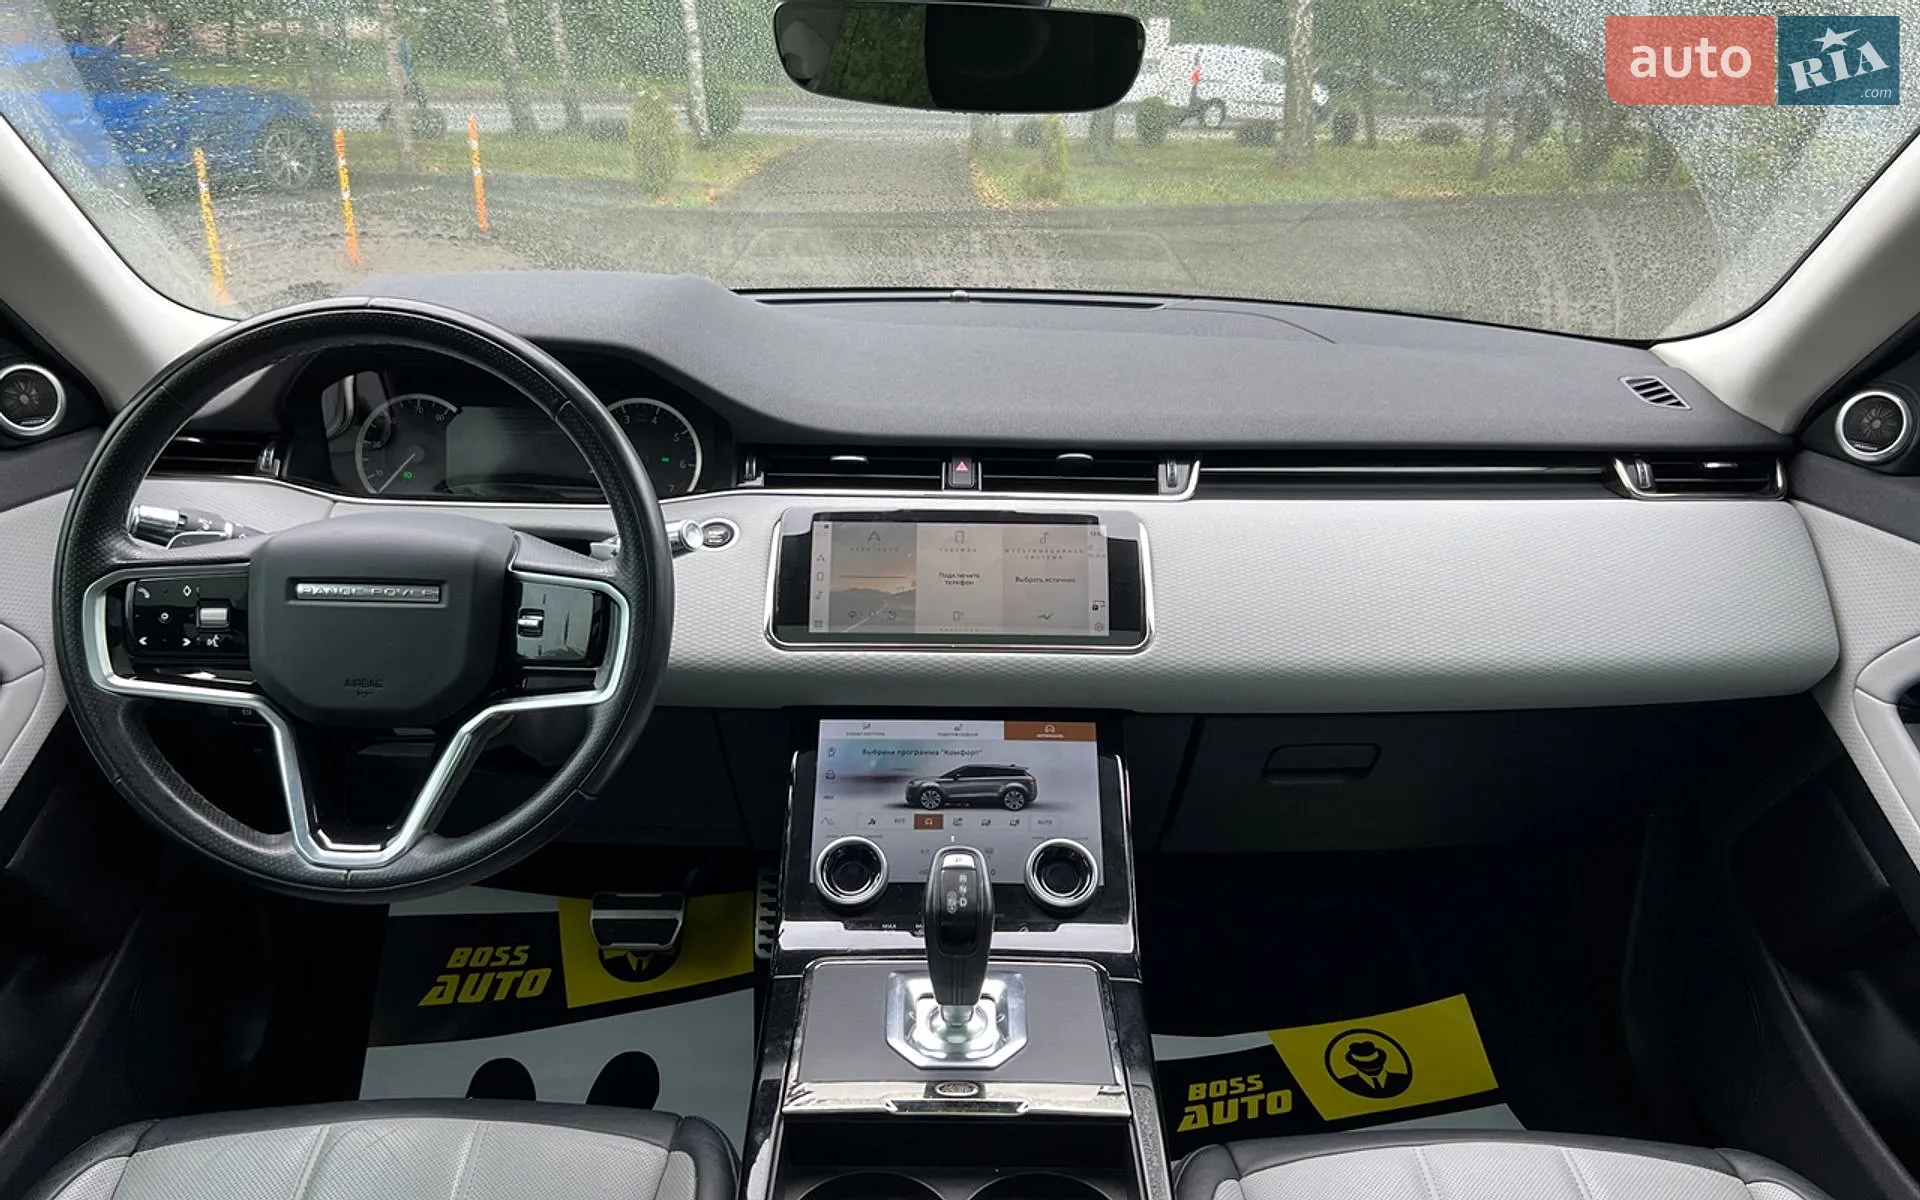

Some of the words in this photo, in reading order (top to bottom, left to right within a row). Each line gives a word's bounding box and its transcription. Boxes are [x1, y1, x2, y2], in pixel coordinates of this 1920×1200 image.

[343, 678, 384, 688] AIRBAG
[959, 897, 968, 908] D
[445, 944, 531, 969] BOSS
[416, 967, 553, 1008] AUTO
[1187, 1073, 1264, 1102] BOSS
[1175, 1088, 1293, 1133] AUTO
